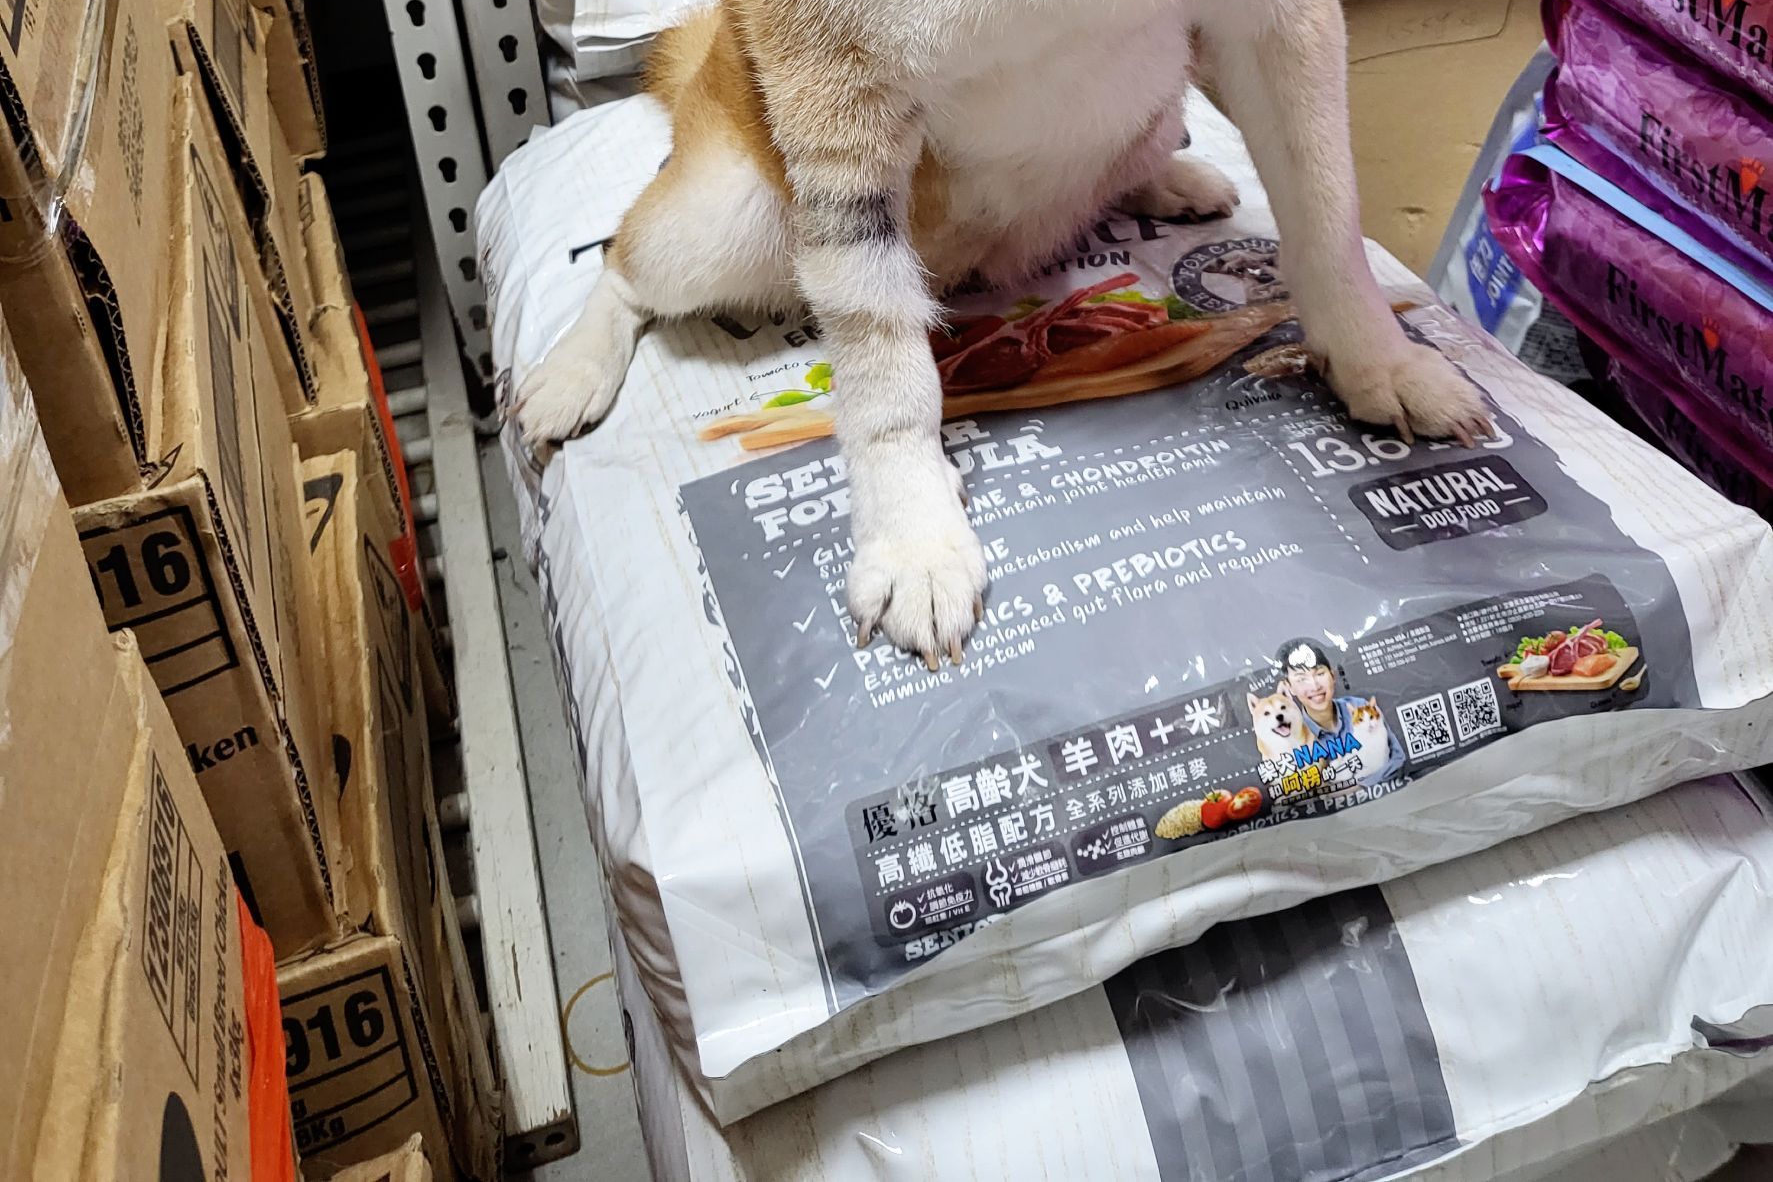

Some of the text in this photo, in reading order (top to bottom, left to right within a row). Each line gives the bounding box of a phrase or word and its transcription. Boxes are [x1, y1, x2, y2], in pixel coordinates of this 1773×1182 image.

[1640, 106, 1773, 243] FirstM
[1608, 261, 1773, 421] FirstMat
[969, 492, 1057, 529] maintain
[1063, 478, 1107, 506] joint
[1112, 463, 1177, 492] health
[1180, 453, 1218, 474] and
[1364, 465, 1518, 518] NATURAL
[1419, 498, 1502, 531] DOG FOOD
[91, 529, 192, 611] 16
[986, 532, 1102, 582] metabolism
[1108, 517, 1147, 541] and
[1149, 508, 1193, 531] help
[1196, 483, 1287, 516] maintain
[1072, 529, 1248, 596] PREBIOTICS
[970, 611, 1067, 653] balanced
[1072, 596, 1108, 626] gut
[1112, 580, 1169, 609] flora
[1174, 564, 1213, 589] and
[1217, 539, 1305, 575] regulate
[869, 636, 1037, 709] immune system
[941, 753, 1050, 818] 高齡犬
[873, 801, 1058, 888] 高纖低脂配方
[144, 771, 177, 1006] 12308916
